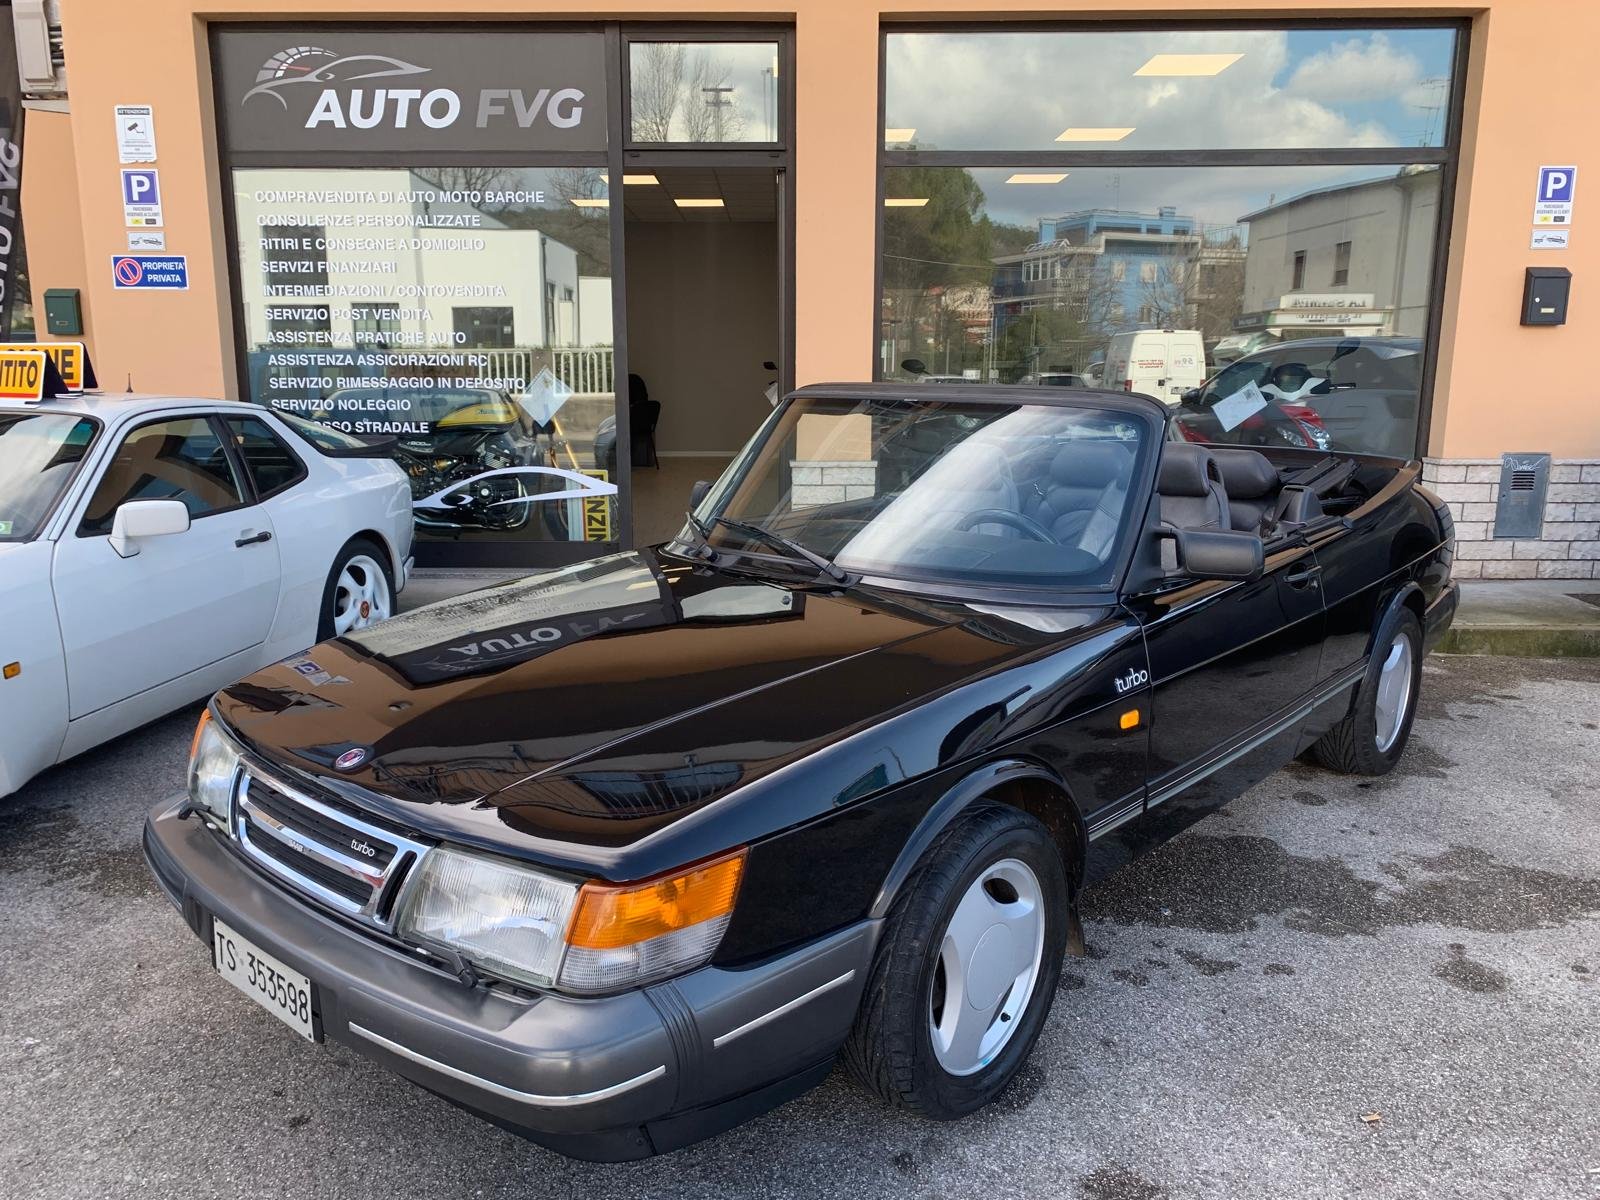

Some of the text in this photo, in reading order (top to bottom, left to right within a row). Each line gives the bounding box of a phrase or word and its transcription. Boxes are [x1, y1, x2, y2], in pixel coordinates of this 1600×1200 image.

[305, 88, 585, 129] AUTO FVG
[130, 175, 151, 201] P
[1546, 172, 1568, 198] P
[255, 190, 545, 203] COMPRAVENDITA DI AUTO MOTO BARCHE
[257, 214, 481, 227] CONSULENZE PERSONALIZZATE
[259, 238, 485, 251] RITIRI E CONSEGNE A DOMICILIO
[260, 261, 397, 273] SERVIZI FINANZIARI
[147, 274, 182, 283] PRIVATA
[263, 284, 385, 297] INTERMEDIAZIONI
[397, 284, 507, 297] CONTOVENDITA
[264, 308, 433, 321] SERVIZIO POST VENDITA
[266, 331, 467, 344] ASSISTENZA PRATICHE AUTO
[268, 354, 489, 367] ASSISTENZA ASSICURAZIONI RC
[269, 377, 527, 390] SERVIZIO RIMESSAGGIO IN DEPOSITO
[271, 399, 412, 411] SERVIZIO NOLEGGIO
[353, 421, 430, 433] STRADALE
[1114, 668, 1149, 693] turbo
[350, 838, 376, 858] turbo
[216, 931, 309, 1024] TS 353598
